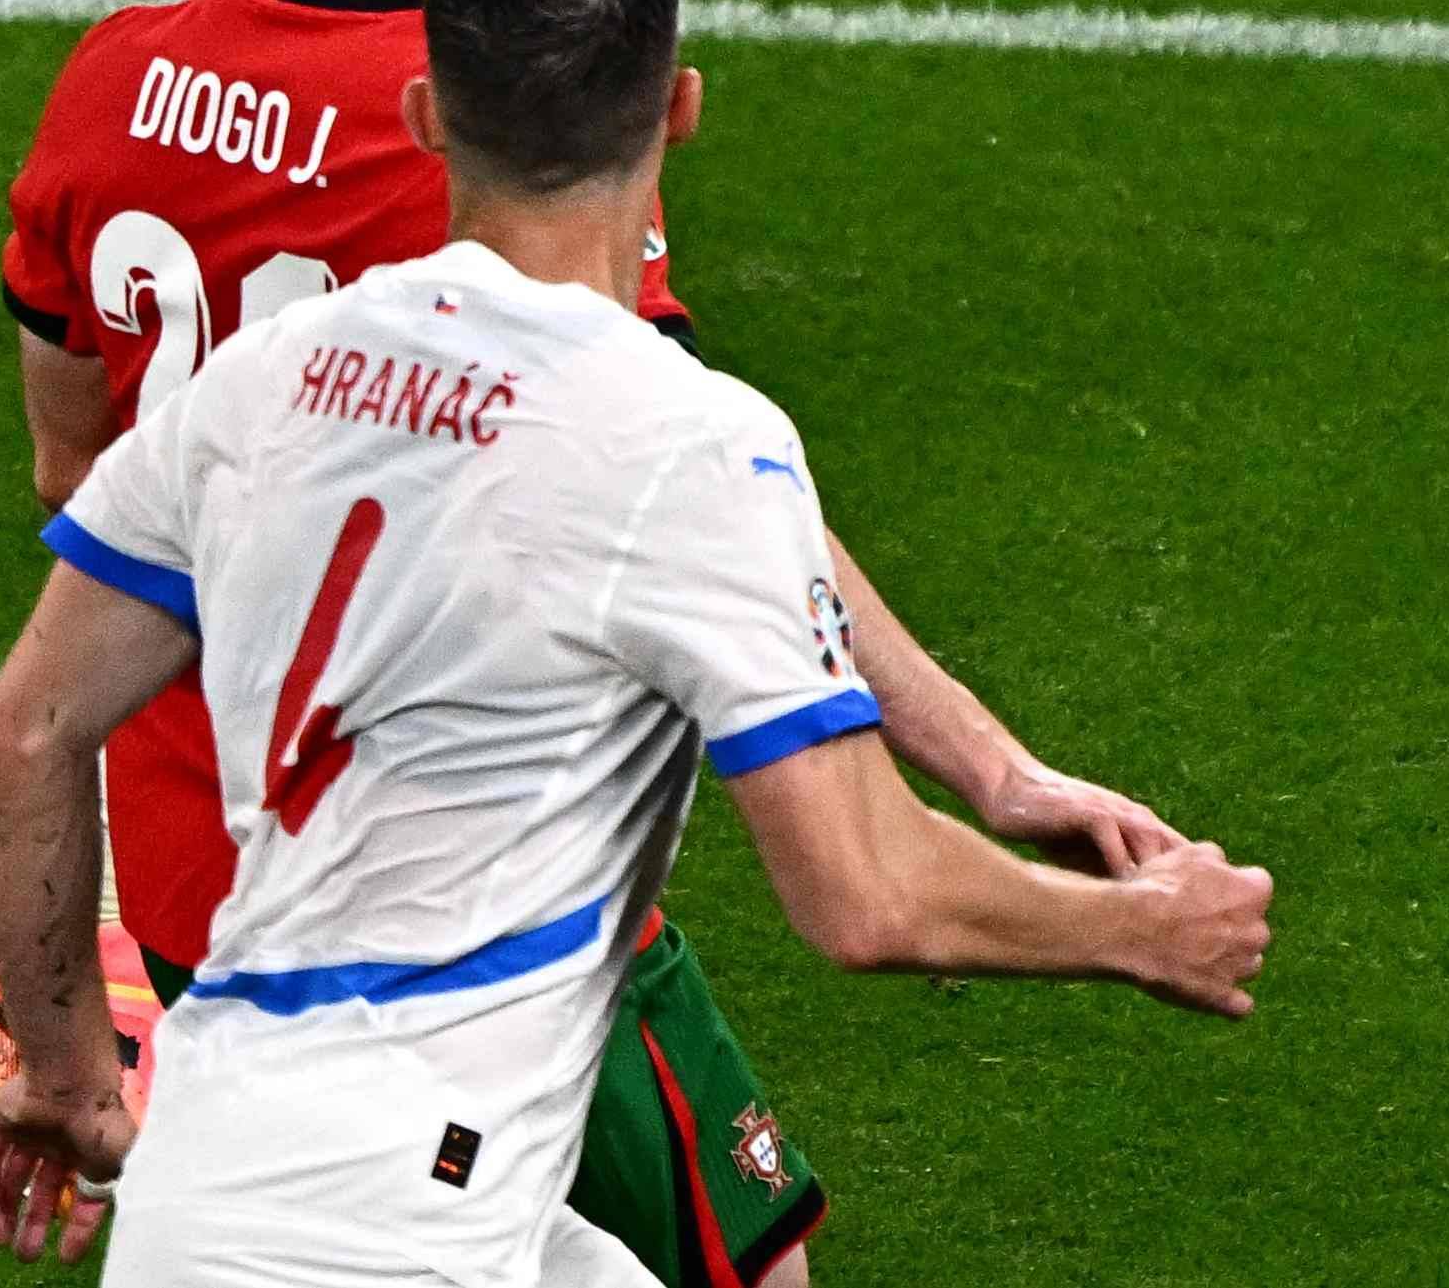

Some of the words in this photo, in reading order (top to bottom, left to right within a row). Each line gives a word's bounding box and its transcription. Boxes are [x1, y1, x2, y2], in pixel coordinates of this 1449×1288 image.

[128, 55, 291, 175] DIOGO
[286, 104, 339, 189] J.
[290, 345, 521, 446] HRANÁČ
